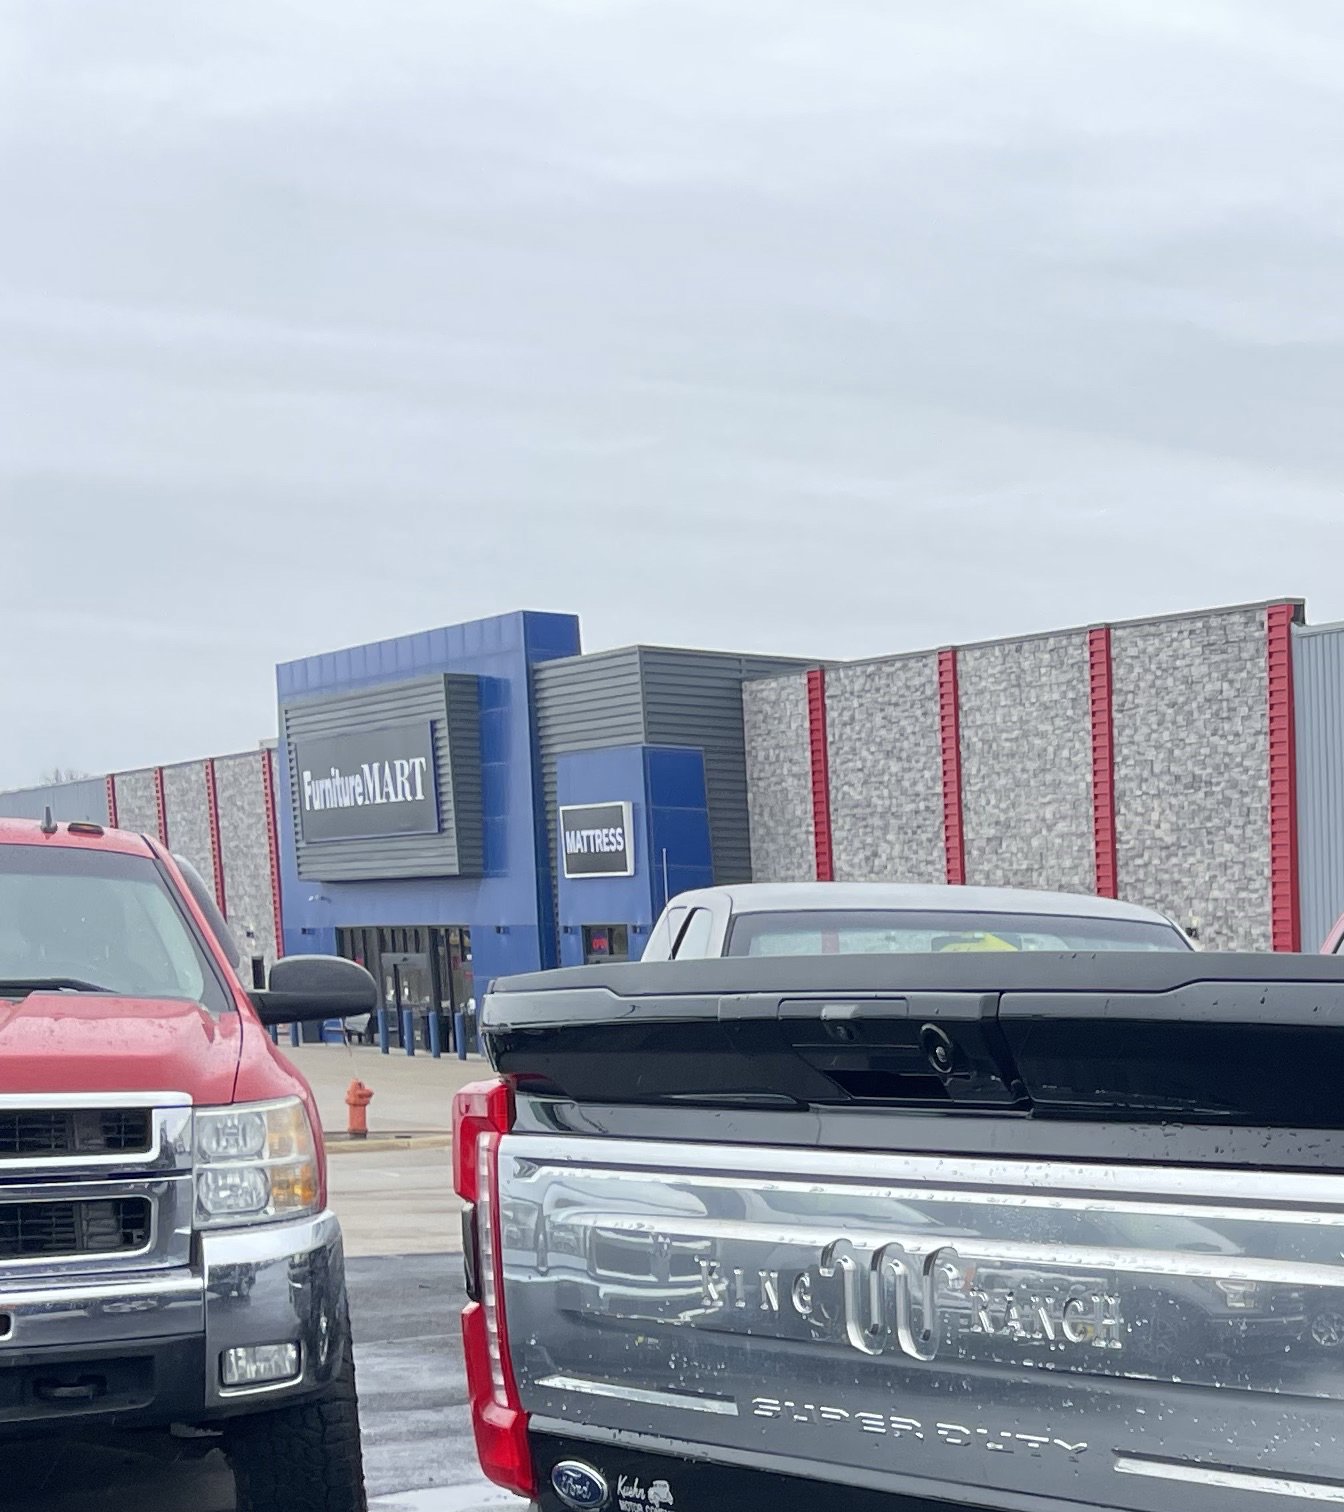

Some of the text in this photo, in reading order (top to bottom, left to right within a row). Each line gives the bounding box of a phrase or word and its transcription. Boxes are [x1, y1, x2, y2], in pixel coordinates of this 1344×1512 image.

[565, 827, 625, 854] MATTRESS
[694, 1255, 1124, 1350] KING RANCH
[752, 1396, 1088, 1464] SUPER DUTY
[560, 1470, 592, 1500] Ford
